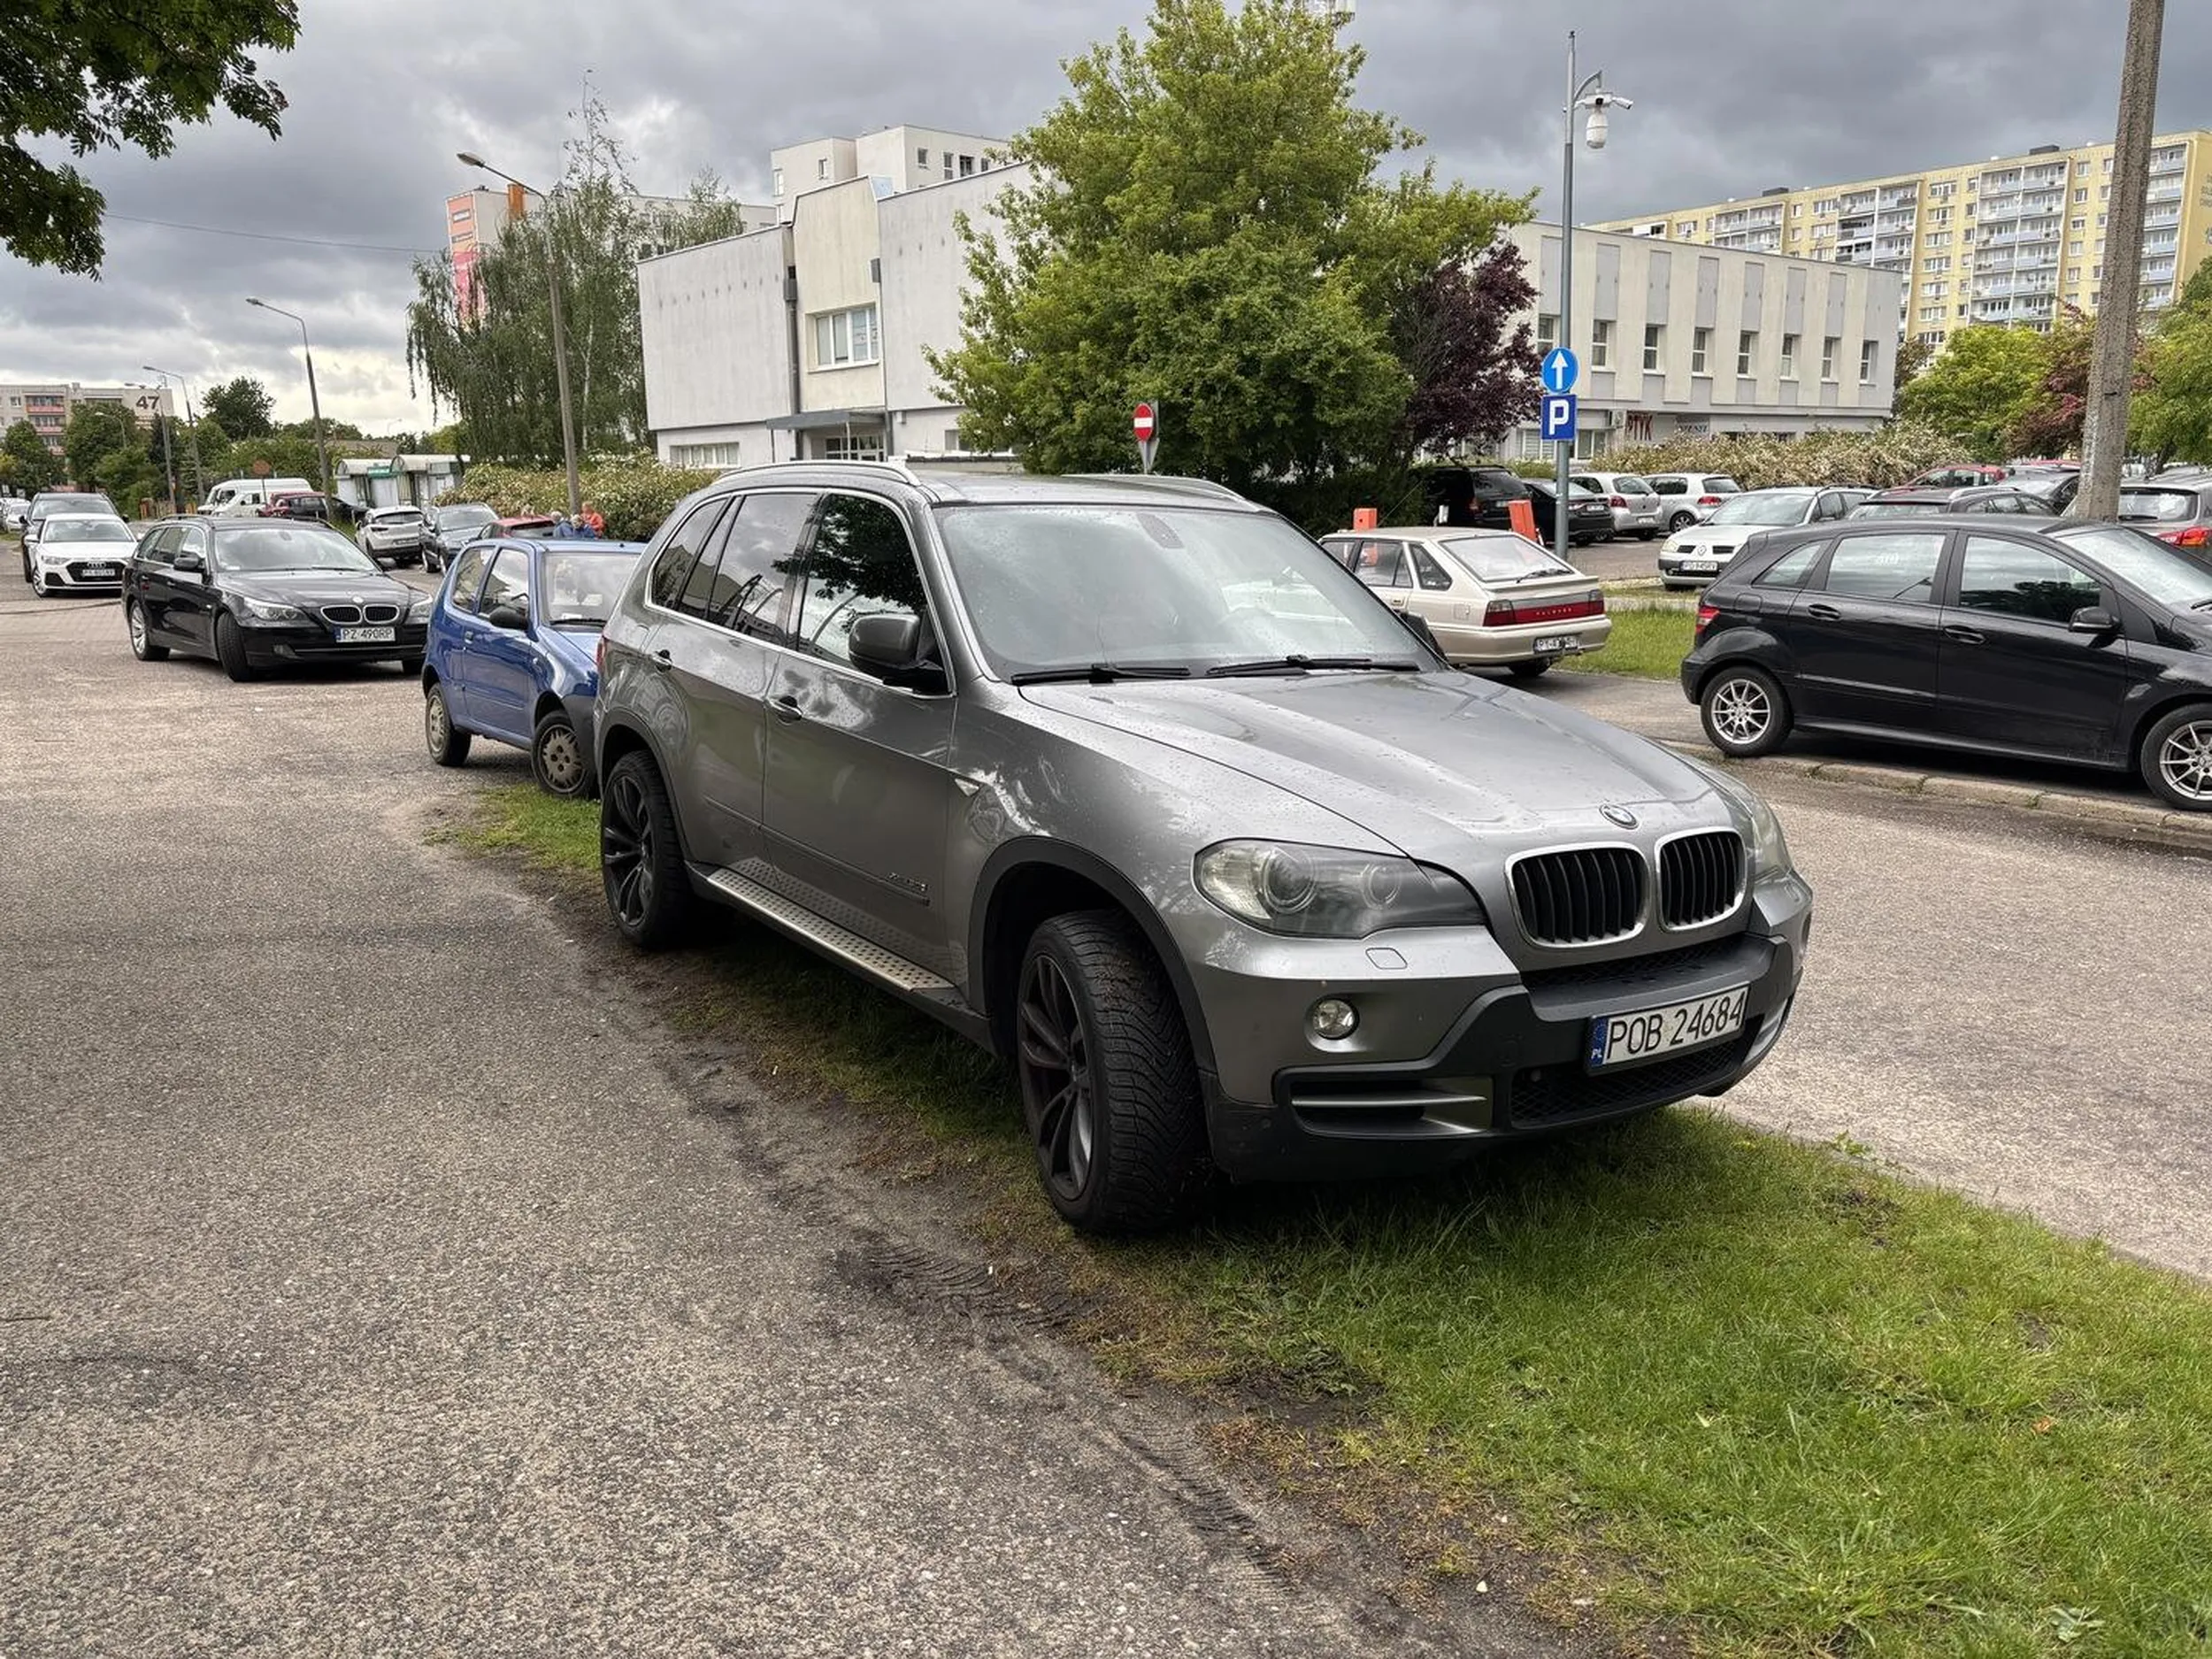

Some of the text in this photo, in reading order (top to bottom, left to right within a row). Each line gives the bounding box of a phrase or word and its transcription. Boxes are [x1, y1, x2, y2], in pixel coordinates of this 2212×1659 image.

[135, 396, 160, 410] 47
[1548, 399, 1570, 435] P
[1607, 990, 1746, 1060] POB 24684
[1591, 1048, 1603, 1060] PL
